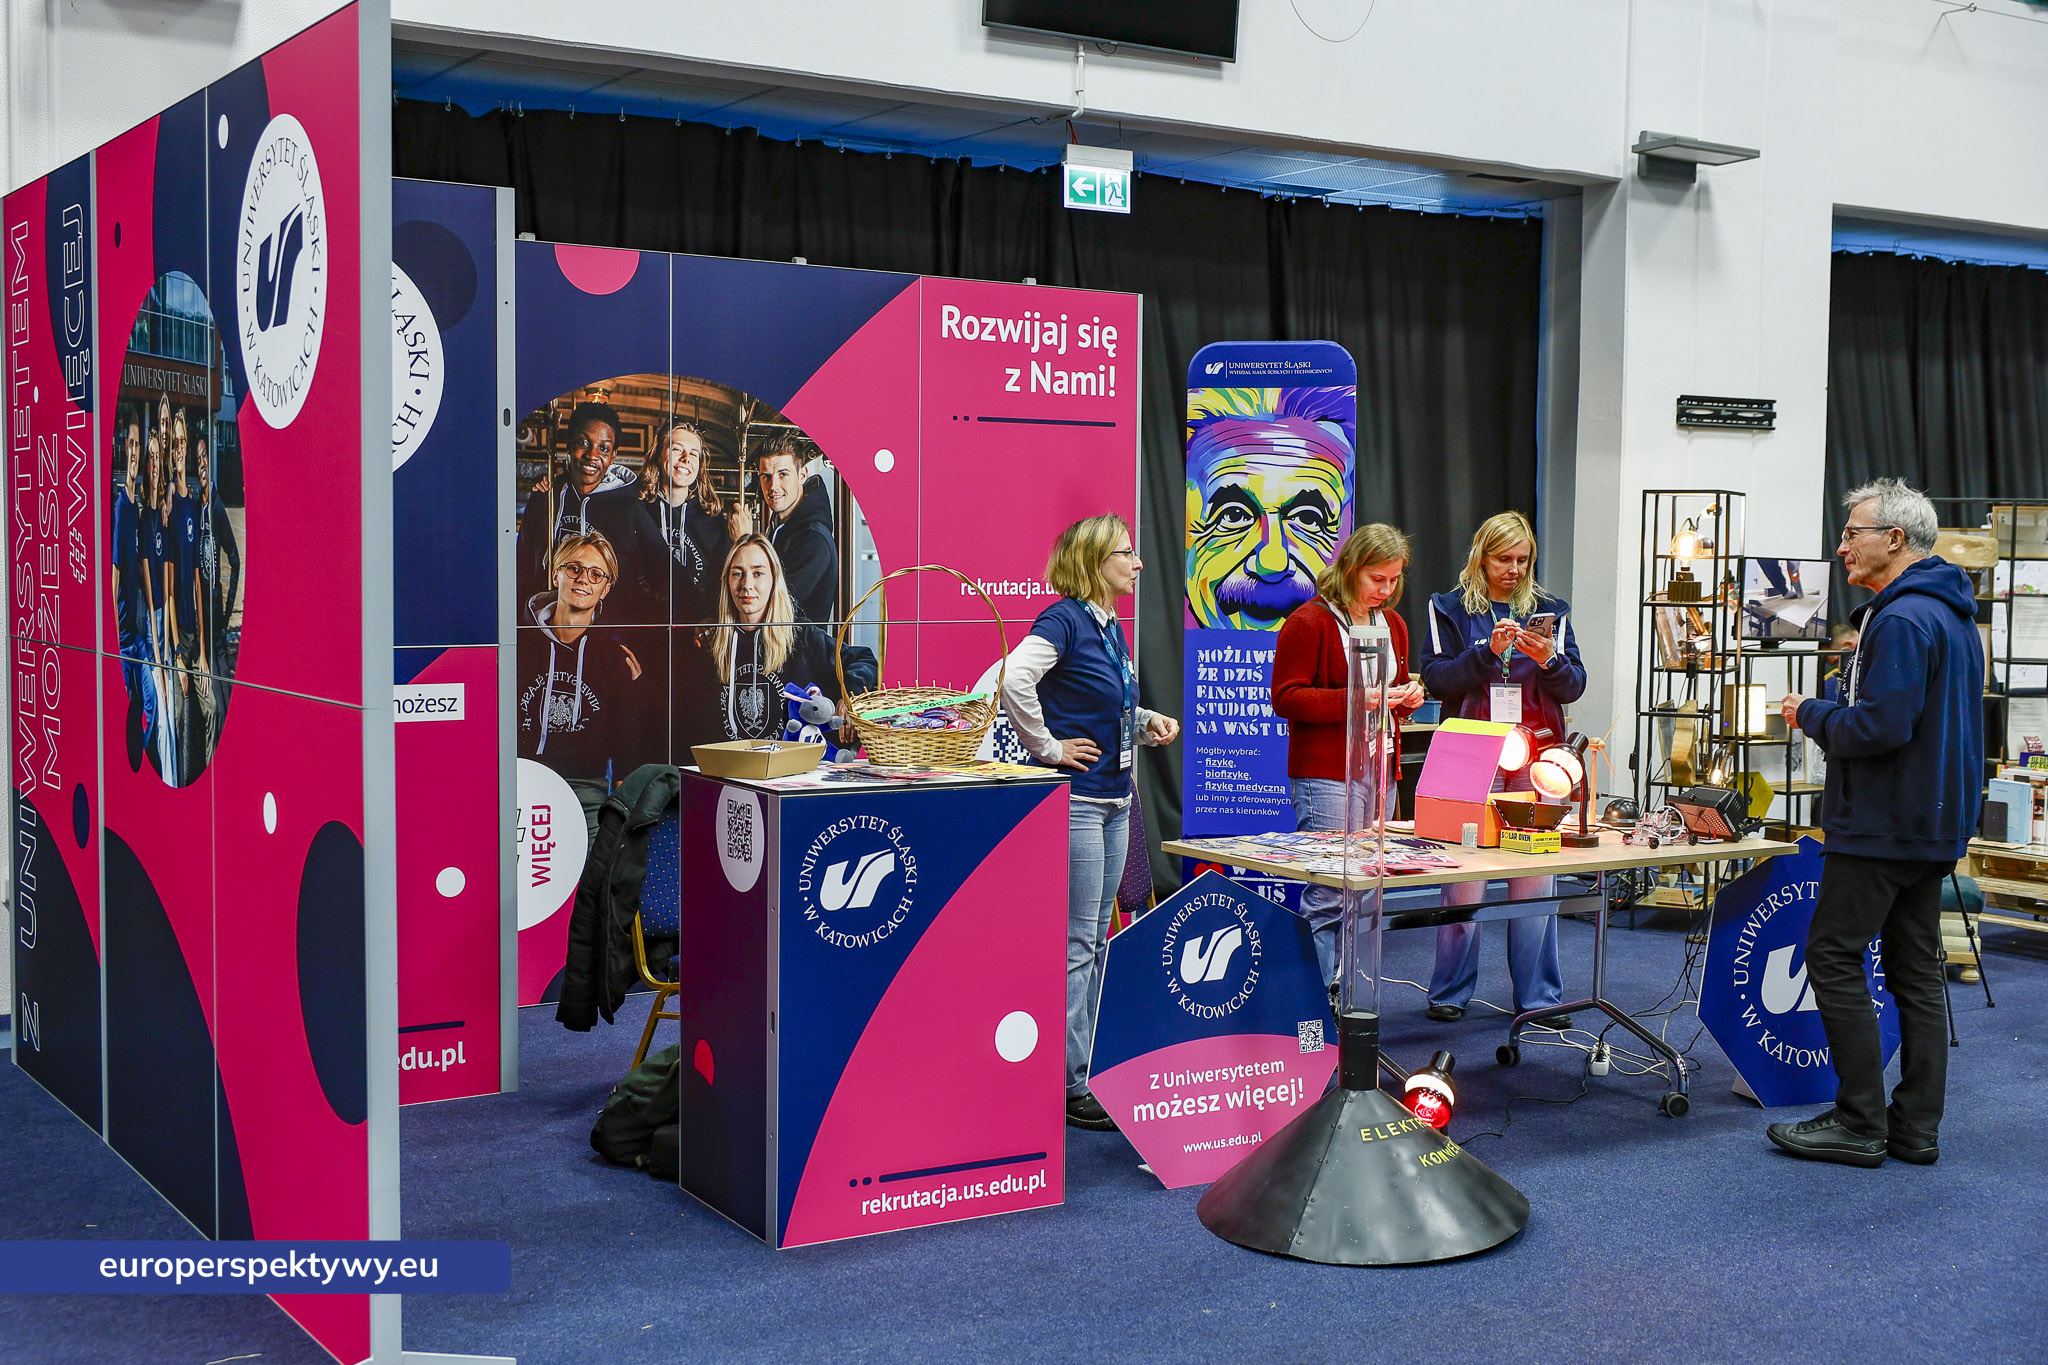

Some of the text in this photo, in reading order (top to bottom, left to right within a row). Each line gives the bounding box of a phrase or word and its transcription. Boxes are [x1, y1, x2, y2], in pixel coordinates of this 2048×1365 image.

[243, 137, 321, 293] UNIWERSYTET ŚLĄSKI
[392, 277, 430, 381] LĄSKI
[941, 304, 1118, 358] Rozwijaj się
[245, 304, 318, 409] W KATOWICACH
[1228, 360, 1311, 370] UNIWERSYTET ŚLĄSKI
[63, 203, 91, 584] #WIĘCEJ
[123, 363, 181, 394] UNIWERSYTET
[1004, 360, 1116, 398] z Nami!
[960, 577, 1060, 600] rekrutacja.u
[37, 434, 62, 790] MOŻESZ
[11, 221, 40, 1051] Z UNIWERSYTETEM
[1197, 663, 1263, 682] ŻE DZIŚ
[1195, 718, 1290, 736] NA WNŚT U
[1196, 702, 1276, 718] STUDIOW
[1196, 746, 1261, 757] Mógłby wybrać:
[1205, 757, 1237, 768] fizykę,
[1205, 769, 1252, 781] biofizykę,
[1205, 781, 1286, 795] fizykę medyczną
[1195, 793, 1209, 802] lub
[1211, 793, 1229, 803] inny
[1237, 795, 1292, 806] oferowanych
[1195, 806, 1217, 814] przez
[1236, 807, 1280, 816] kierunków
[531, 803, 556, 888] WIĘCEJ
[798, 815, 918, 893] UNIWERSYTET ŚLĄSKI
[803, 895, 914, 949] W KATOWICACH
[1162, 893, 1262, 967] UNIWERSYTET ŚLĄSKI
[1733, 881, 1819, 988] UNIWERSYT
[1167, 968, 1260, 1019] W KATOWICACH
[398, 1041, 467, 1072] du.pl
[1741, 1003, 1830, 1069] W KATOW
[1163, 1060, 1285, 1088] Uniwersytetem
[1133, 1077, 1304, 1123] możesz więcej!
[1183, 1130, 1263, 1154] www.us.edu.pl
[861, 1168, 1047, 1216] rekrutacja.us.edu.pl
